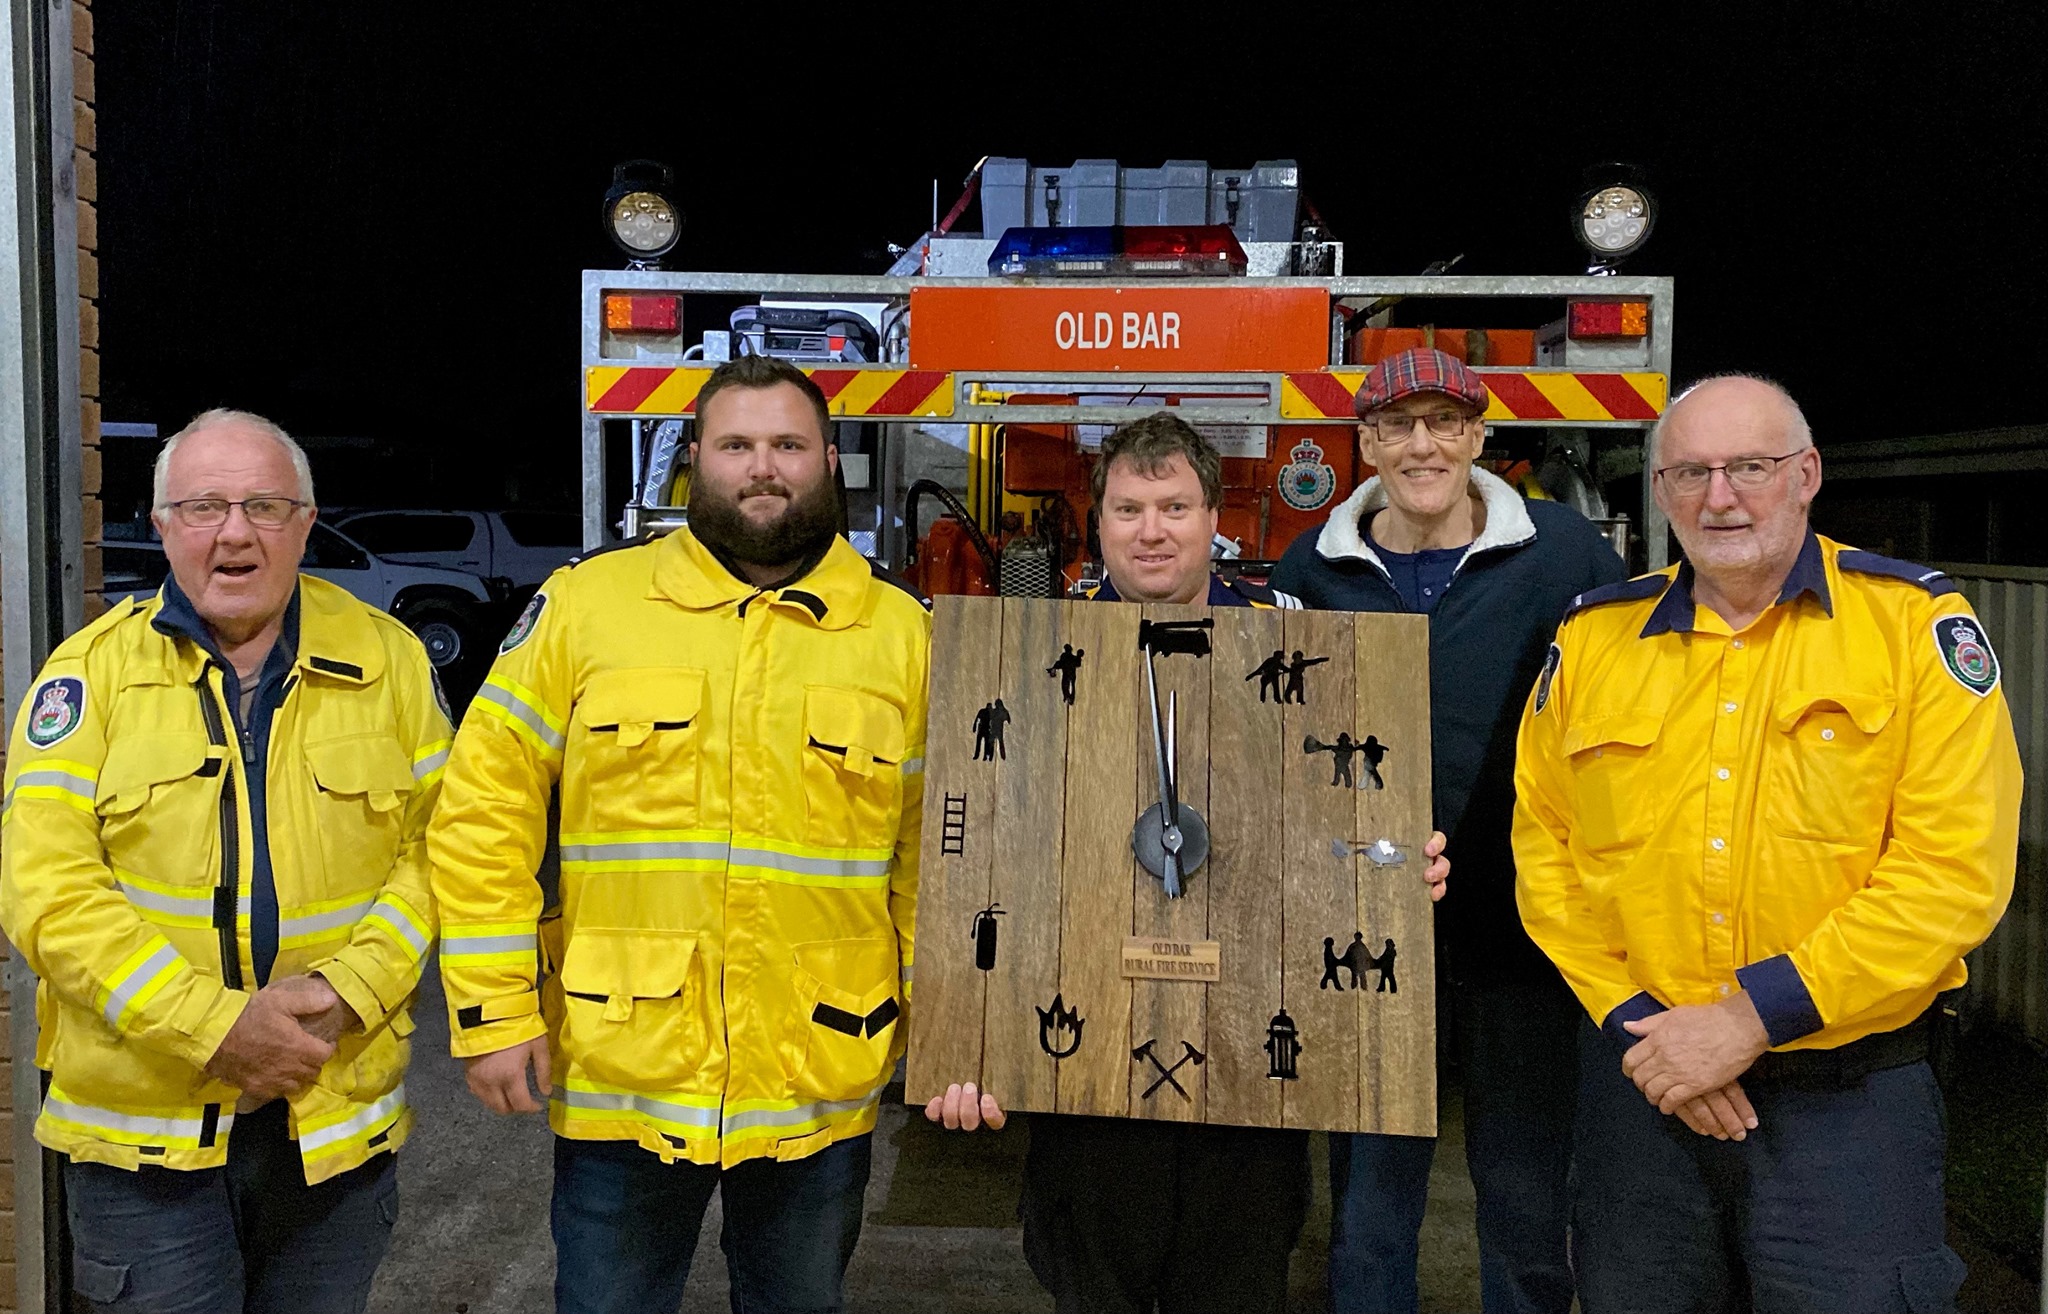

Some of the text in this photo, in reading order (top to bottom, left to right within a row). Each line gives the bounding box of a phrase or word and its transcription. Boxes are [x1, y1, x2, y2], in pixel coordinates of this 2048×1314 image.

[1055, 311, 1181, 350] OLD BAR
[1152, 942, 1192, 957] OLD BAR
[1124, 958, 1217, 976] RURAL FIRE SERVICE
